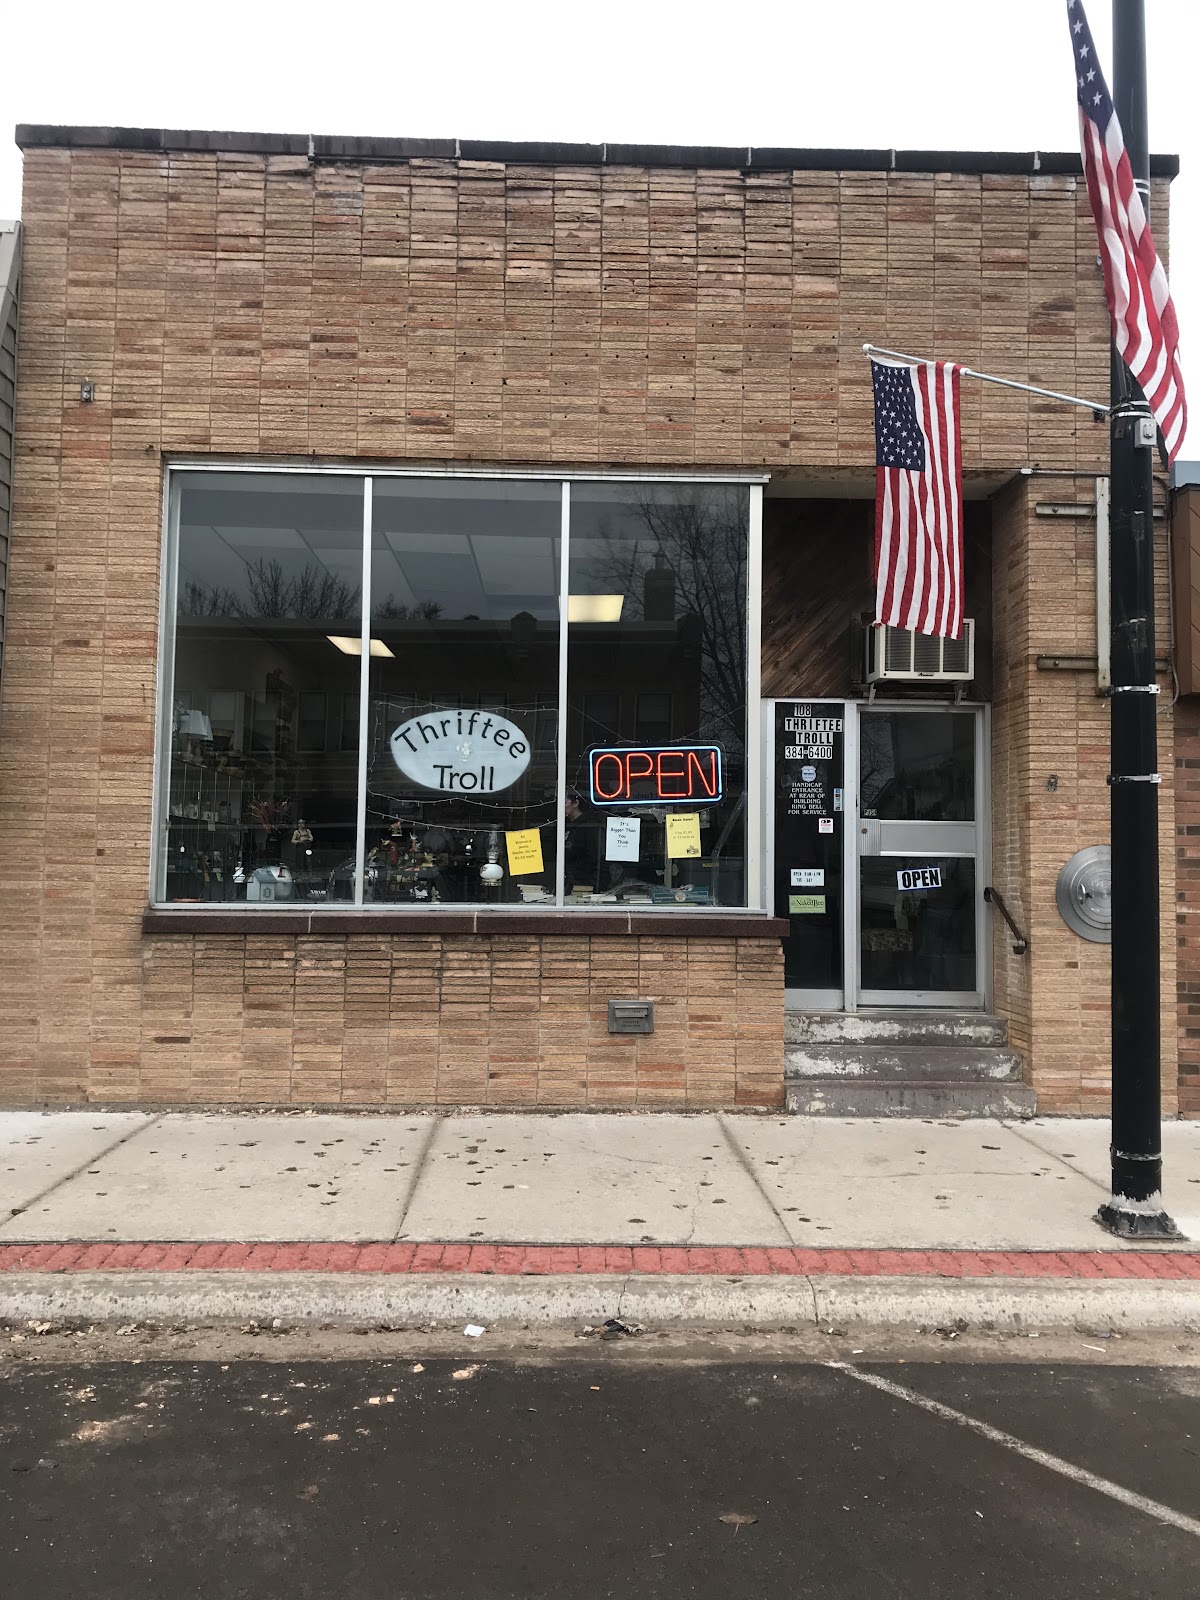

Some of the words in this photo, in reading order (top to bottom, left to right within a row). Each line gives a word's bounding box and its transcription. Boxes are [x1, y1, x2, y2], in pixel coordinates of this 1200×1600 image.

[796, 705, 811, 715] 108
[786, 719, 841, 731] THRIFTEE
[394, 712, 526, 758] Thriftee
[797, 733, 832, 744] TROLL
[785, 747, 832, 758] 384-6400
[433, 764, 494, 790] Troll
[596, 752, 716, 798] OPEN
[902, 870, 939, 888] OPEN
